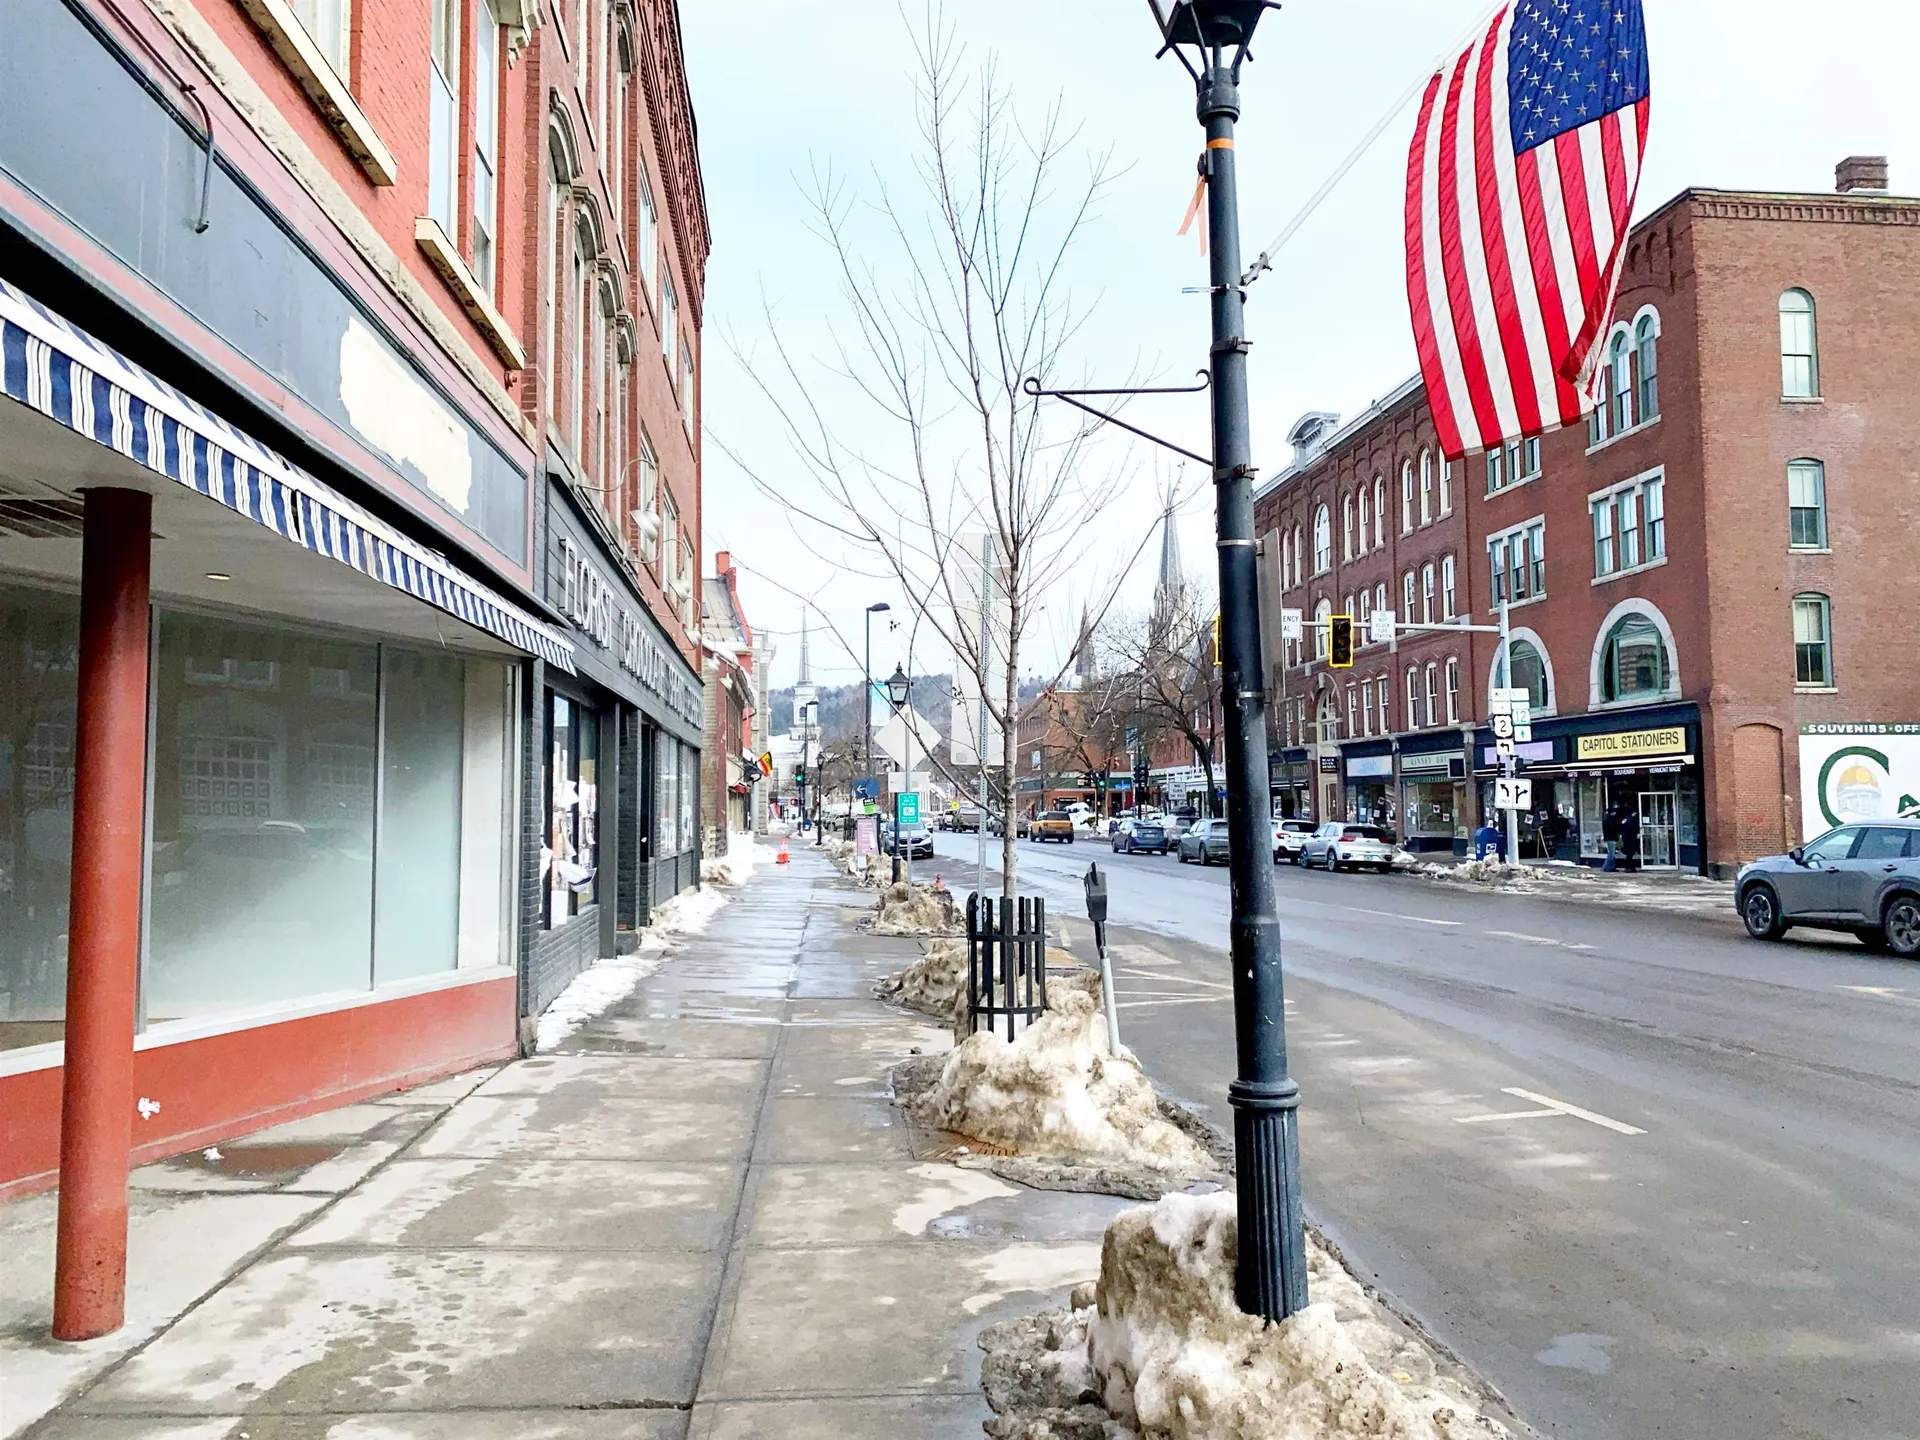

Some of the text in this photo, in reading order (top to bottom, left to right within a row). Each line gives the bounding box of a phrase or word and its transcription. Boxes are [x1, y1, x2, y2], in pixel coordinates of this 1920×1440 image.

[564, 535, 614, 650] FLORIST
[623, 608, 665, 697] CHOCOLATE
[1516, 710, 1526, 723] 12
[1499, 719, 1507, 732] 2
[1808, 724, 1920, 733] SOUVENIRS OFF
[1582, 732, 1679, 752] CAPITOL STATIONERS
[1614, 768, 1635, 776] SOUVENIRS
[1649, 766, 1668, 774] VERMONT
